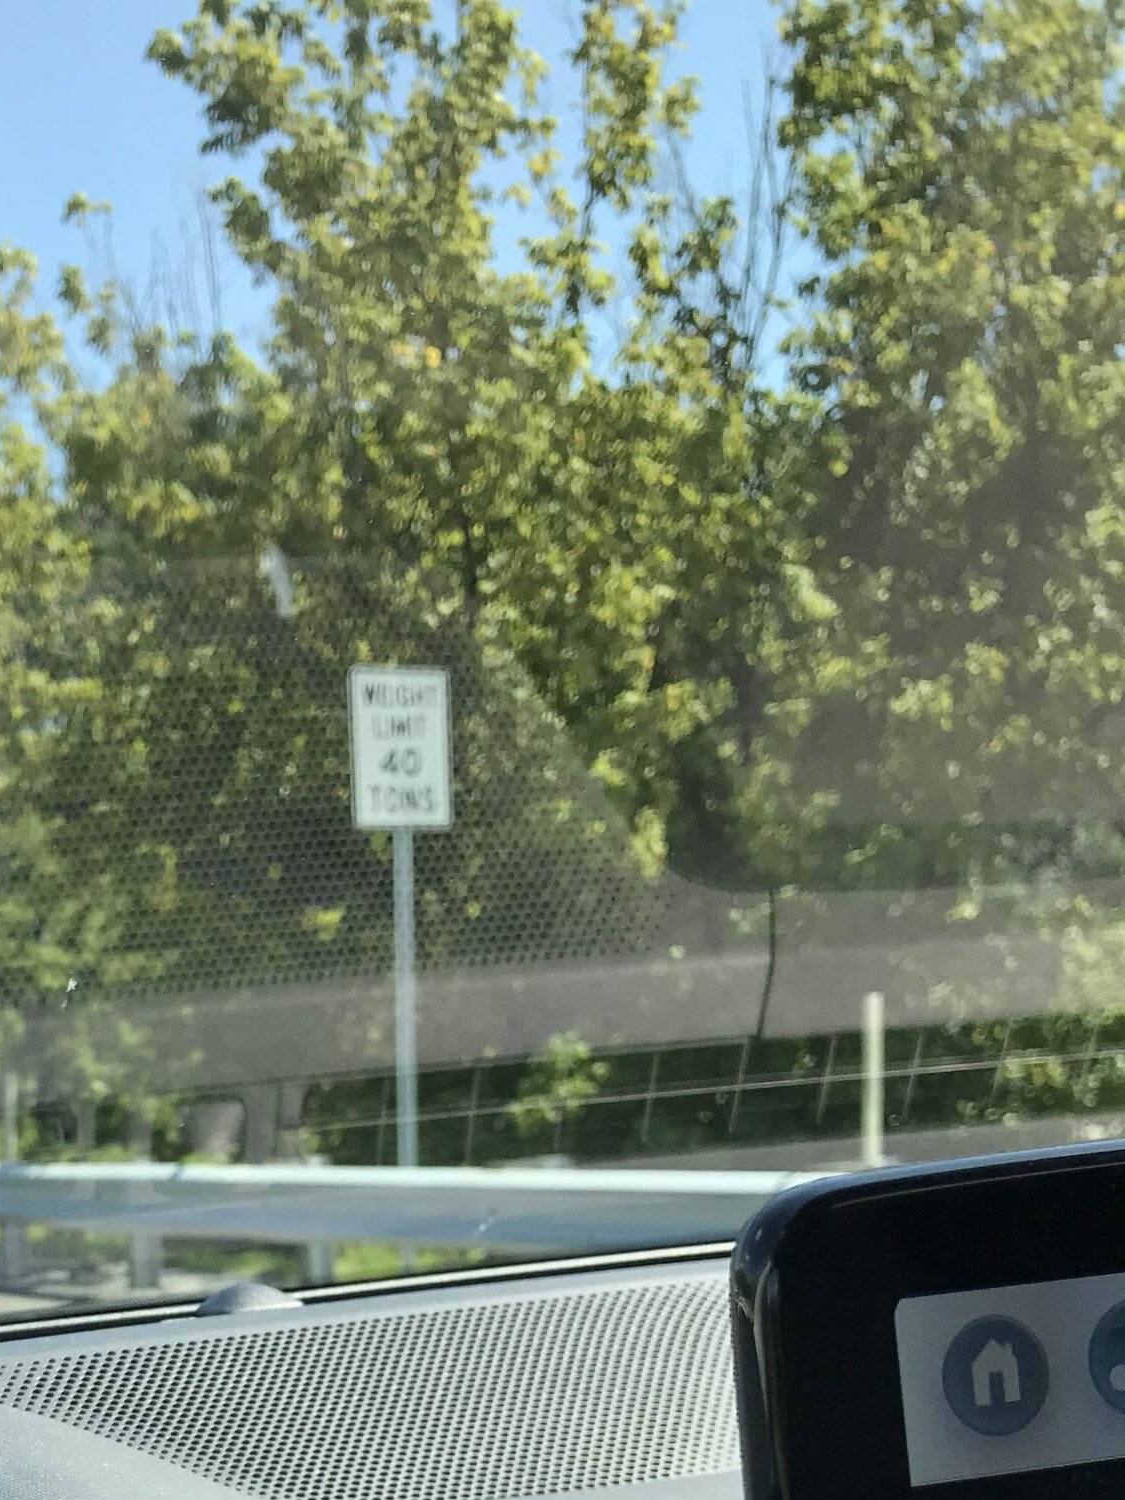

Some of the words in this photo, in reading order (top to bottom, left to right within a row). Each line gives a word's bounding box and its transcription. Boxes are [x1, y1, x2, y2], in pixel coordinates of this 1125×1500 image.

[371, 713, 426, 739] LIMIT
[378, 748, 423, 776] 40
[368, 784, 436, 813] TONS
